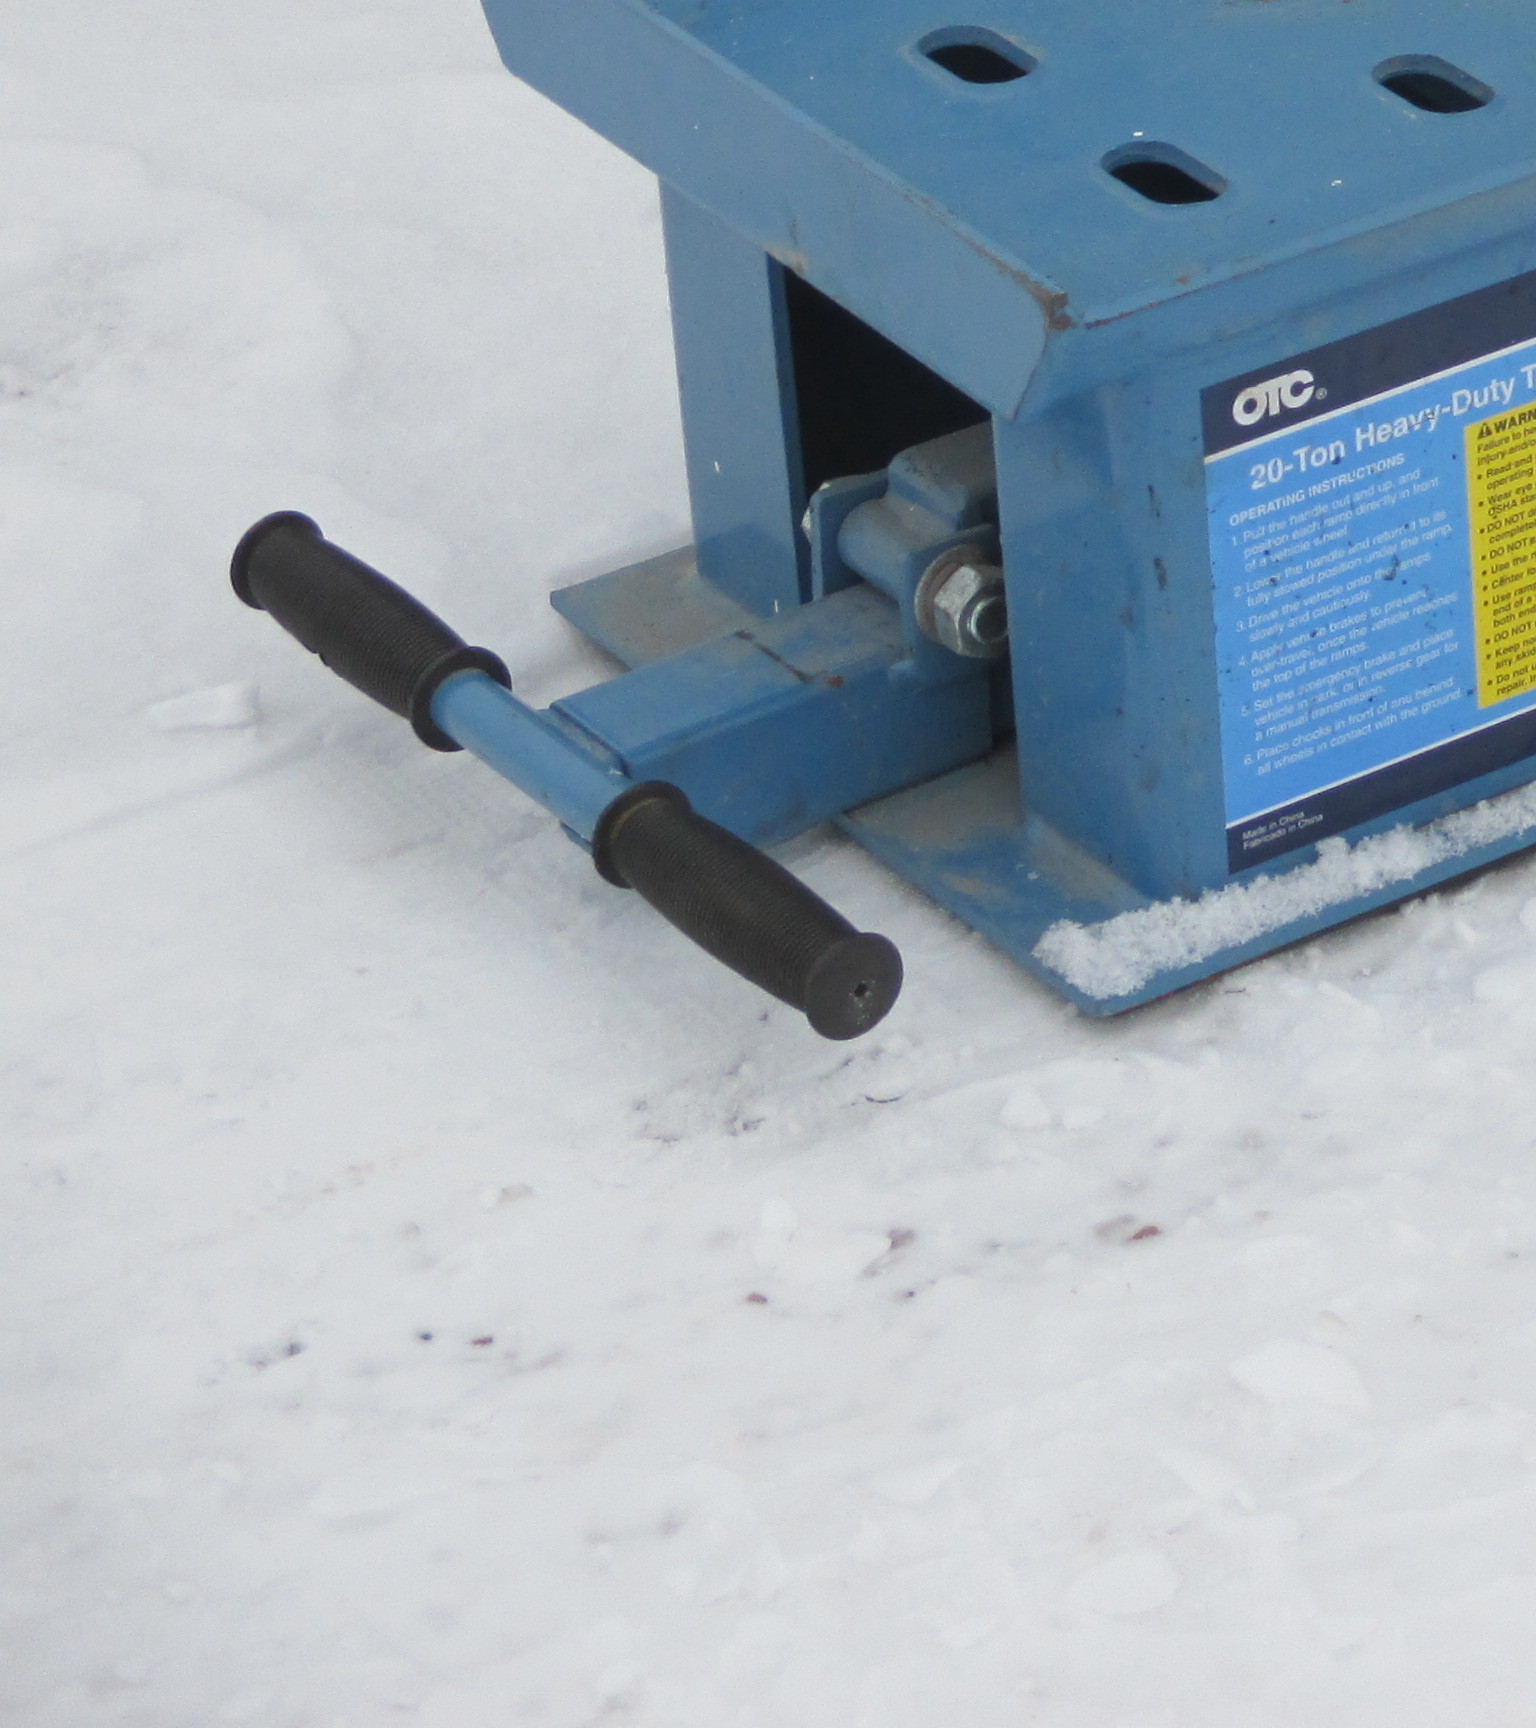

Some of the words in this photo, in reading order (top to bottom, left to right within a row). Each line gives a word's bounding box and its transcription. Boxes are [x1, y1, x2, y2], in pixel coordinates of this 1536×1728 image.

[1232, 368, 1315, 427] OTC
[1249, 437, 1347, 490] 20-Ton
[1352, 376, 1516, 453] Heavy-Duty
[1229, 488, 1305, 527] OPERATING
[1307, 452, 1404, 498] INSTRUCTIONS
[1278, 808, 1304, 826] China
